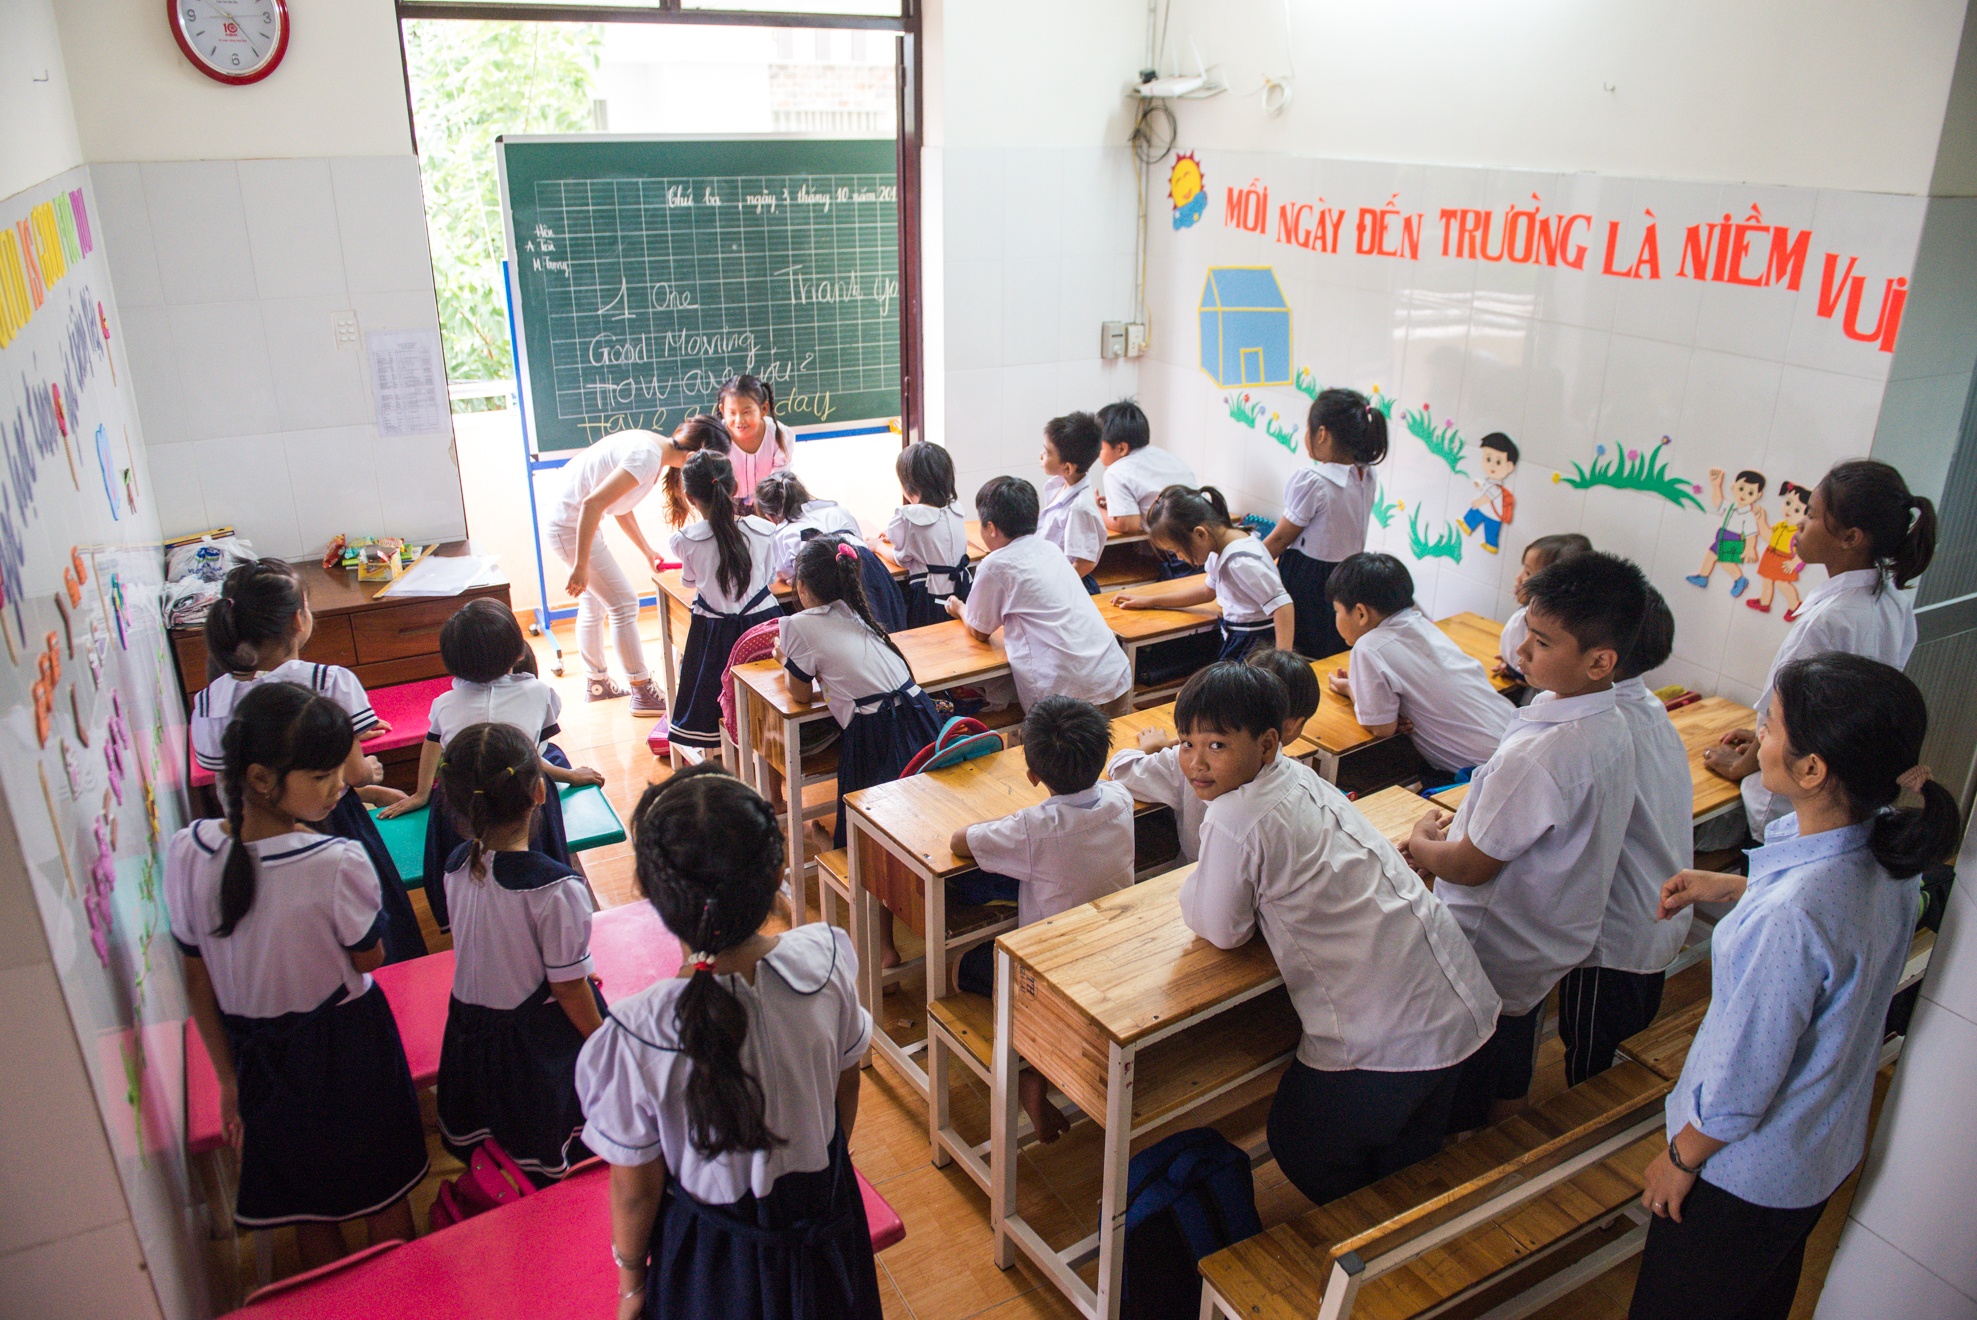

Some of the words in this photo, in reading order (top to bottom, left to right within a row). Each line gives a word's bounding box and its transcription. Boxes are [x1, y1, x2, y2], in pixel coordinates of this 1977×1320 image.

[262, 11, 272, 24] 3
[231, 53, 241, 66] 6
[797, 184, 830, 213] tháng
[836, 186, 850, 203] 10
[1276, 197, 1346, 254] NGÀY
[1355, 192, 1424, 261] ĐẾN
[1439, 191, 1593, 271] TRƯỜNG
[1601, 208, 1662, 281] LÀ
[652, 282, 699, 311] One
[588, 332, 648, 367] Good
[585, 374, 673, 409] How
[576, 406, 668, 444] Have
[773, 386, 837, 422] day
